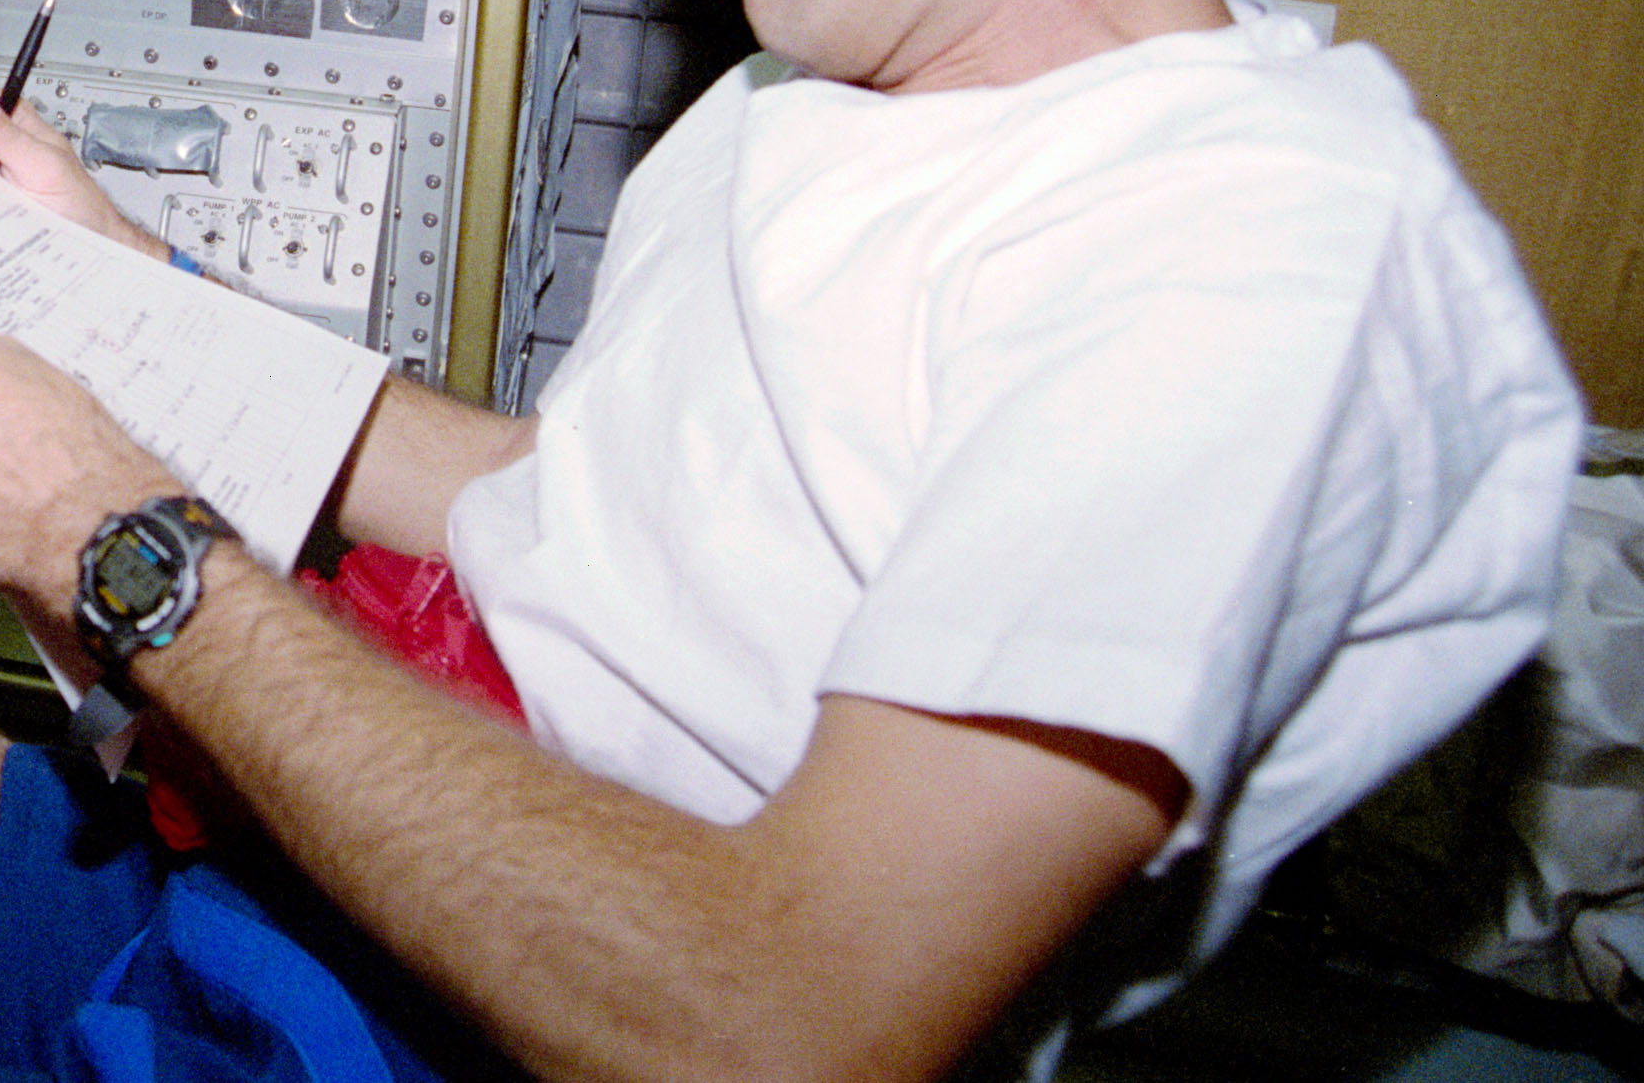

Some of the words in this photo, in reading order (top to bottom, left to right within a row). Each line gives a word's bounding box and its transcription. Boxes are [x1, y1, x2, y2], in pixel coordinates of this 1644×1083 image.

[36, 77, 53, 85] EXP
[295, 126, 313, 135] EXP
[317, 129, 331, 137] AC
[203, 201, 227, 210] PUMP
[267, 201, 280, 209] AC
[283, 211, 307, 220] PUMP
